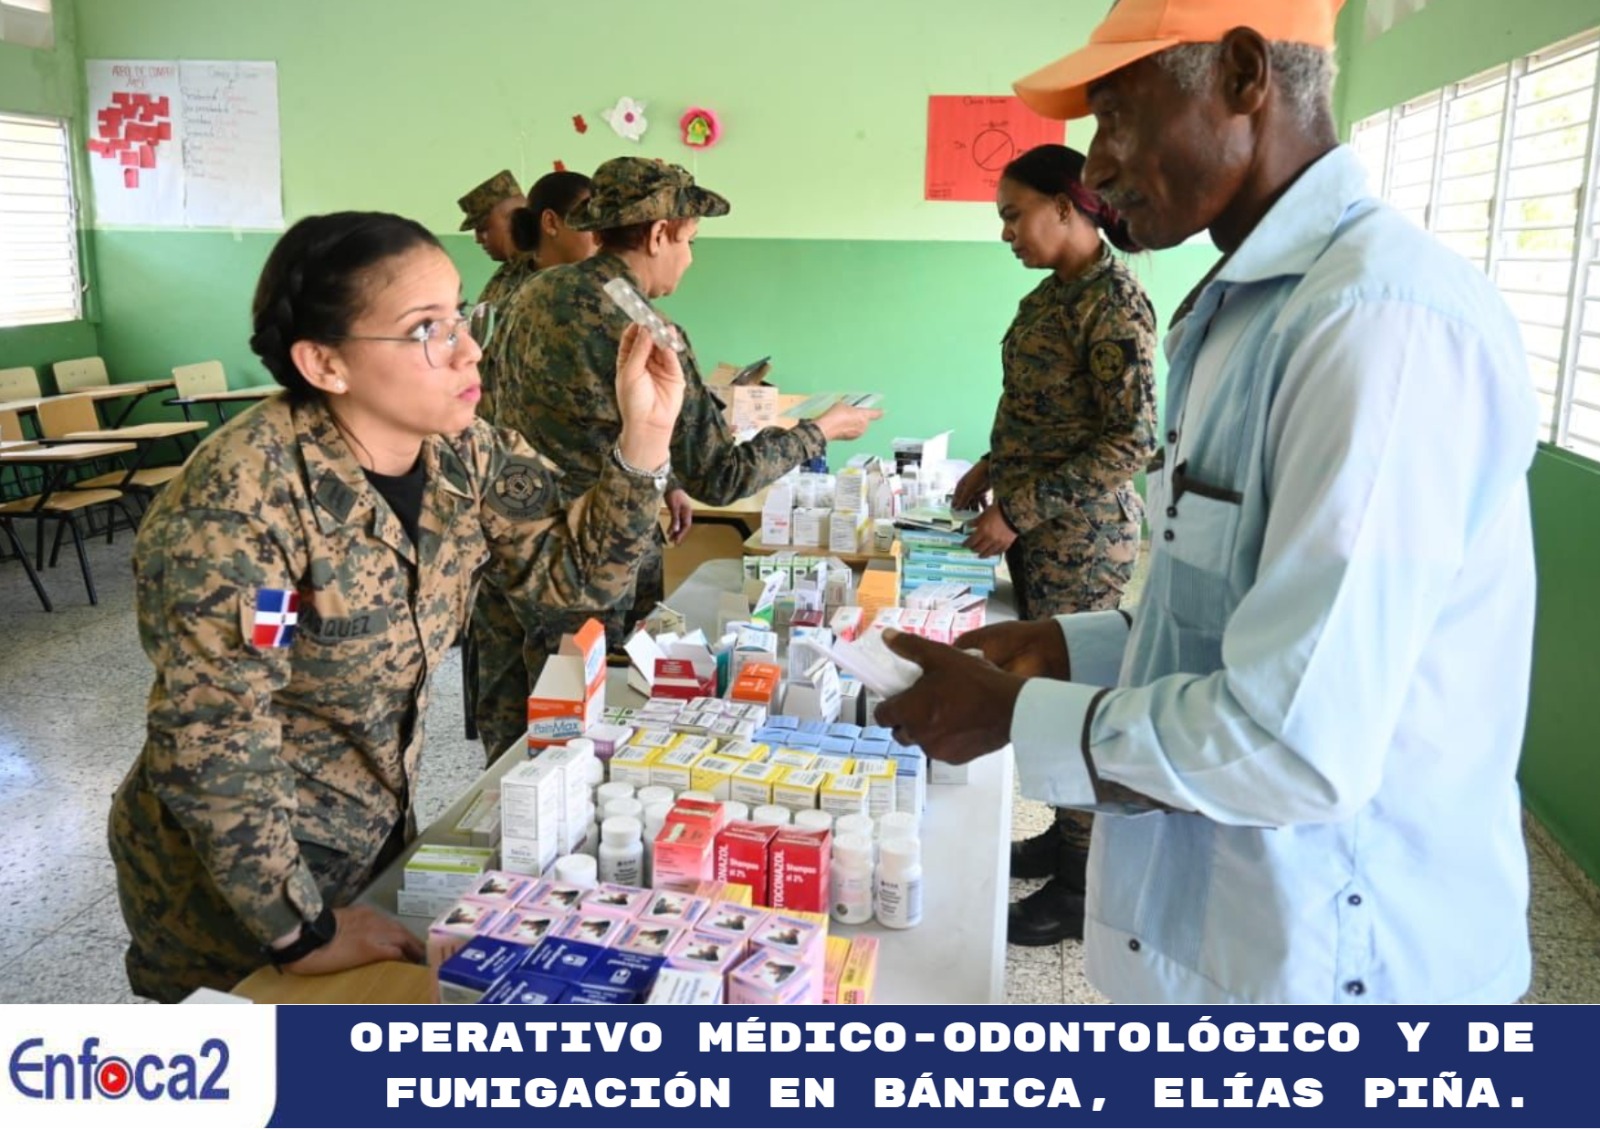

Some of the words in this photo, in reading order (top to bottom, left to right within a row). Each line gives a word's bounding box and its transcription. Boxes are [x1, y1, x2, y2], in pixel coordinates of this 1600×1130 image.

[318, 615, 371, 638] QUEZ
[718, 844, 729, 882] ONAZOL
[729, 858, 759, 871] Shampoo
[786, 864, 817, 875] Shampoo
[773, 849, 785, 909] TOCONAZOL
